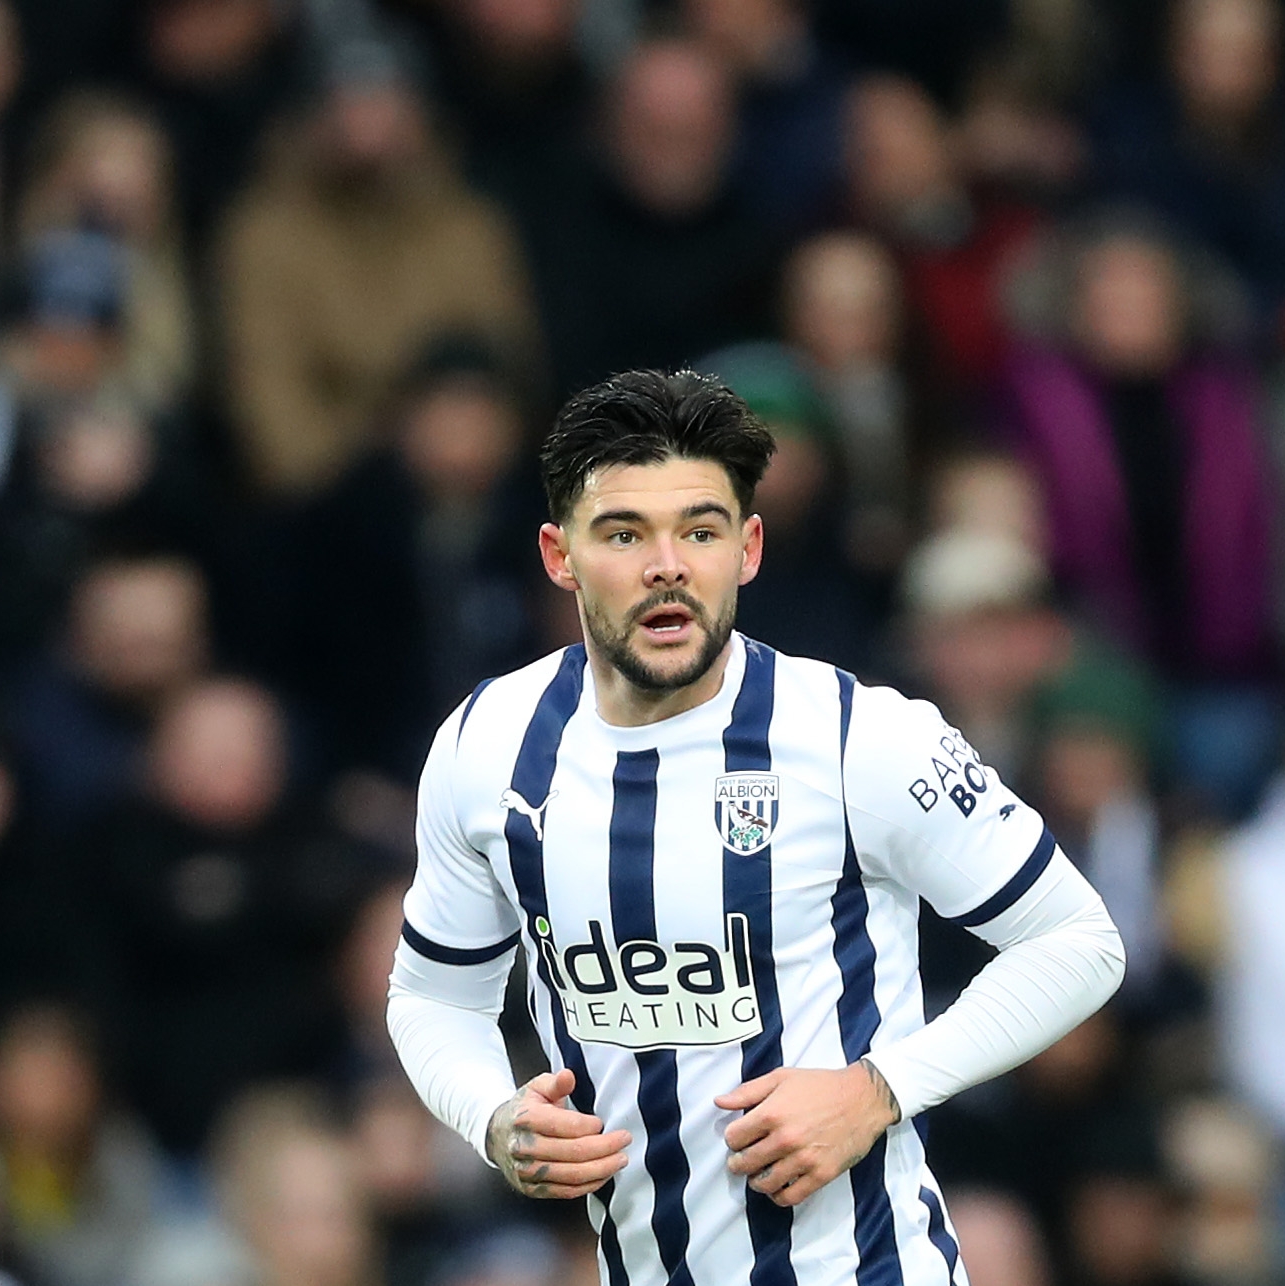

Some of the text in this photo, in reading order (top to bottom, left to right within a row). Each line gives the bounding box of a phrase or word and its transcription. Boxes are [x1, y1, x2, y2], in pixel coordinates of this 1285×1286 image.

[718, 785, 775, 798] ALBION
[948, 752, 988, 818] BO
[536, 914, 752, 995] ideal
[564, 996, 756, 1030] HEATING
